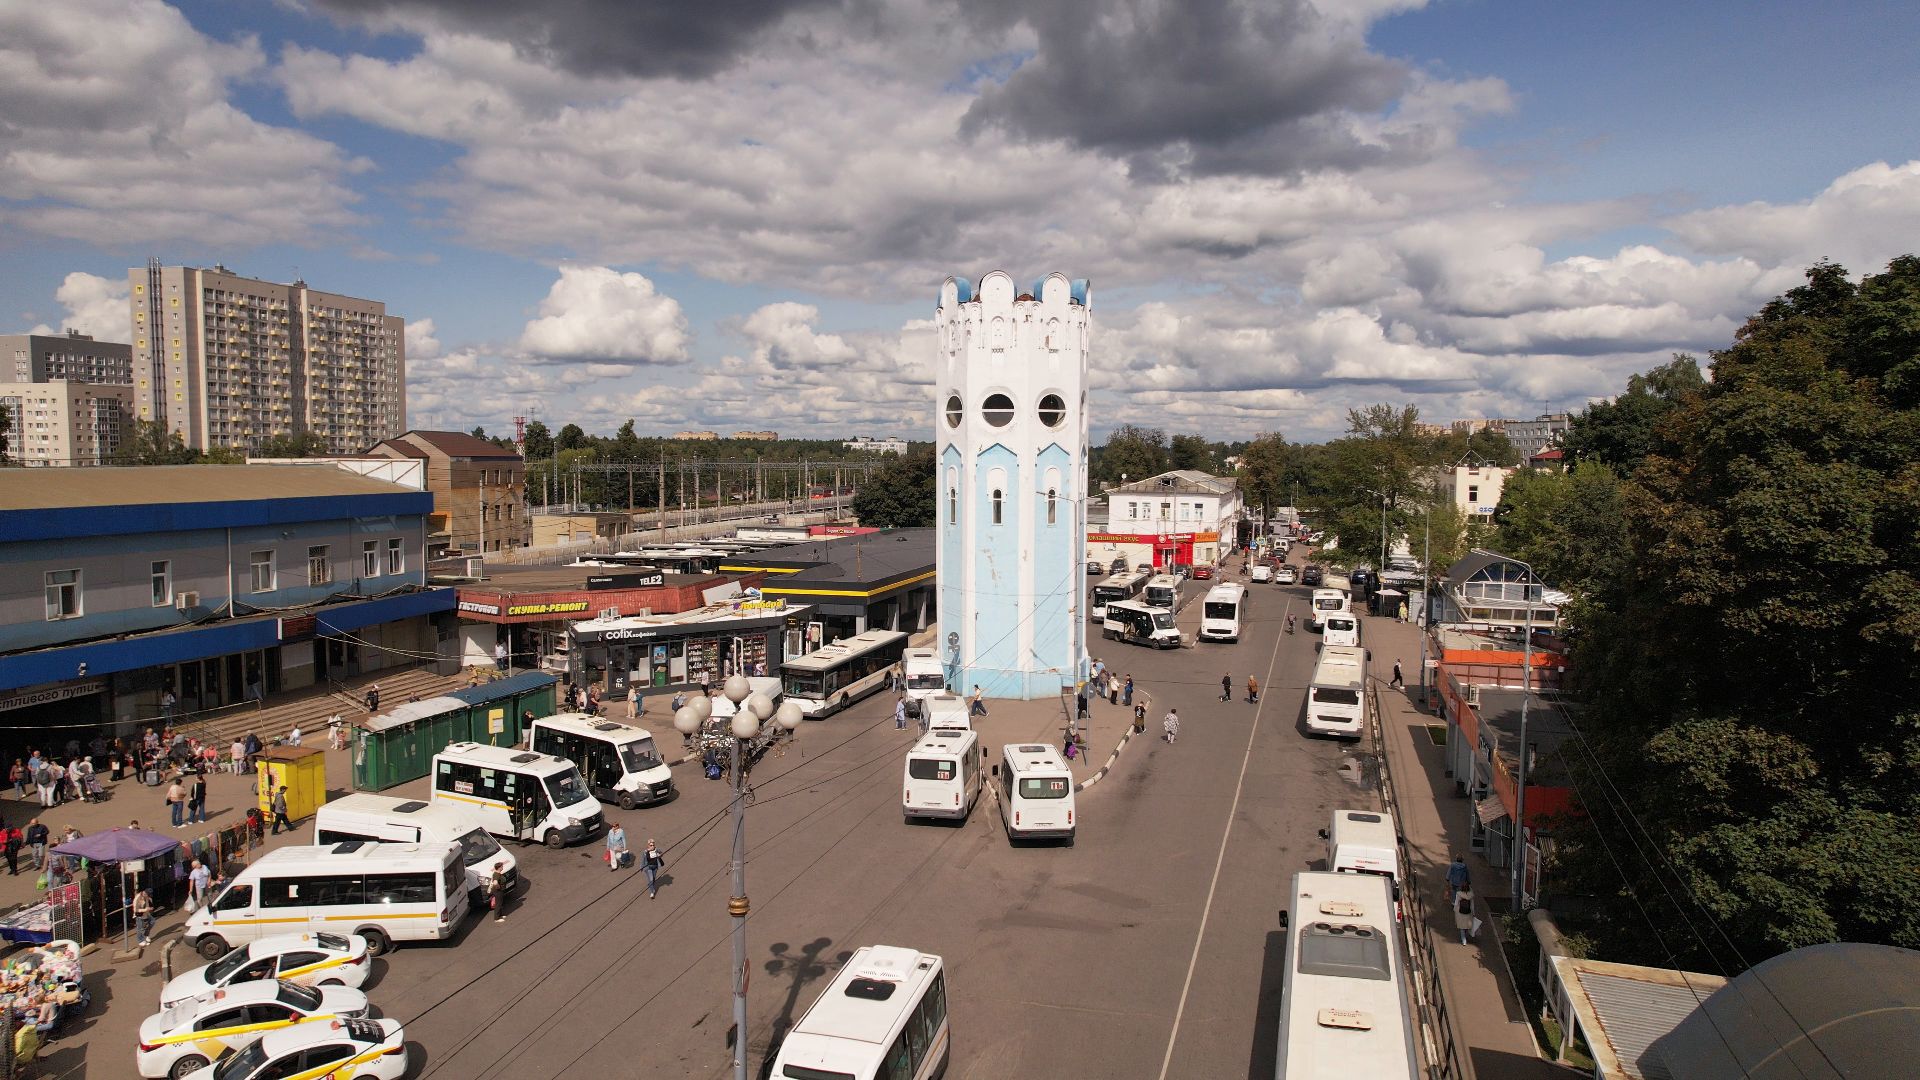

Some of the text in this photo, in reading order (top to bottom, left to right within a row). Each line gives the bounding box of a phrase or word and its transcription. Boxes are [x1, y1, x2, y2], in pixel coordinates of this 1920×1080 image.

[640, 575, 663, 586] TELE2
[459, 601, 499, 615] ГАСТРОНОМ
[508, 602, 588, 616] СКУПКА-РЕМОНТ
[606, 629, 633, 640] cofix
[0, 690, 59, 709] тливого
